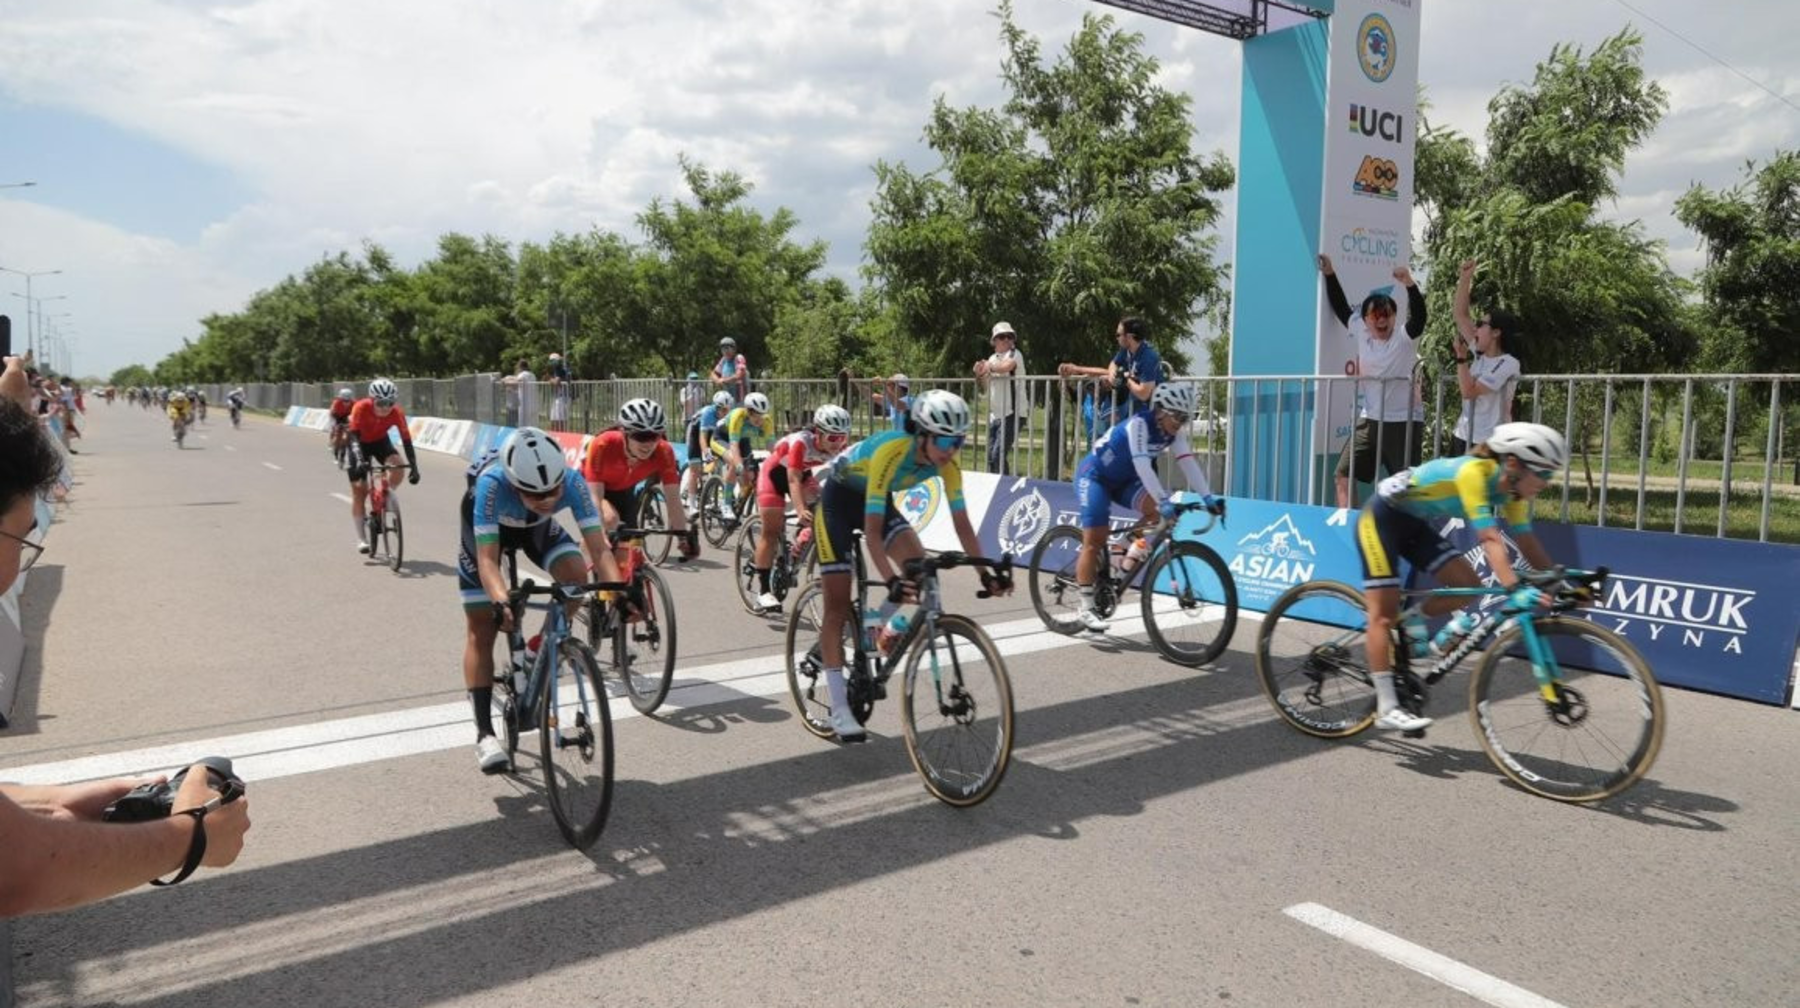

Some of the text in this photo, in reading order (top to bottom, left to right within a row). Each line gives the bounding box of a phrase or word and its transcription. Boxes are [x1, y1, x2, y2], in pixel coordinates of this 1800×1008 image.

[1360, 105, 1402, 143] UCI
[1341, 233, 1398, 258] CYCLING
[1228, 553, 1315, 583] ASIAN
[1592, 579, 1755, 629] MRUK
[1584, 613, 1742, 655] ZYNA
